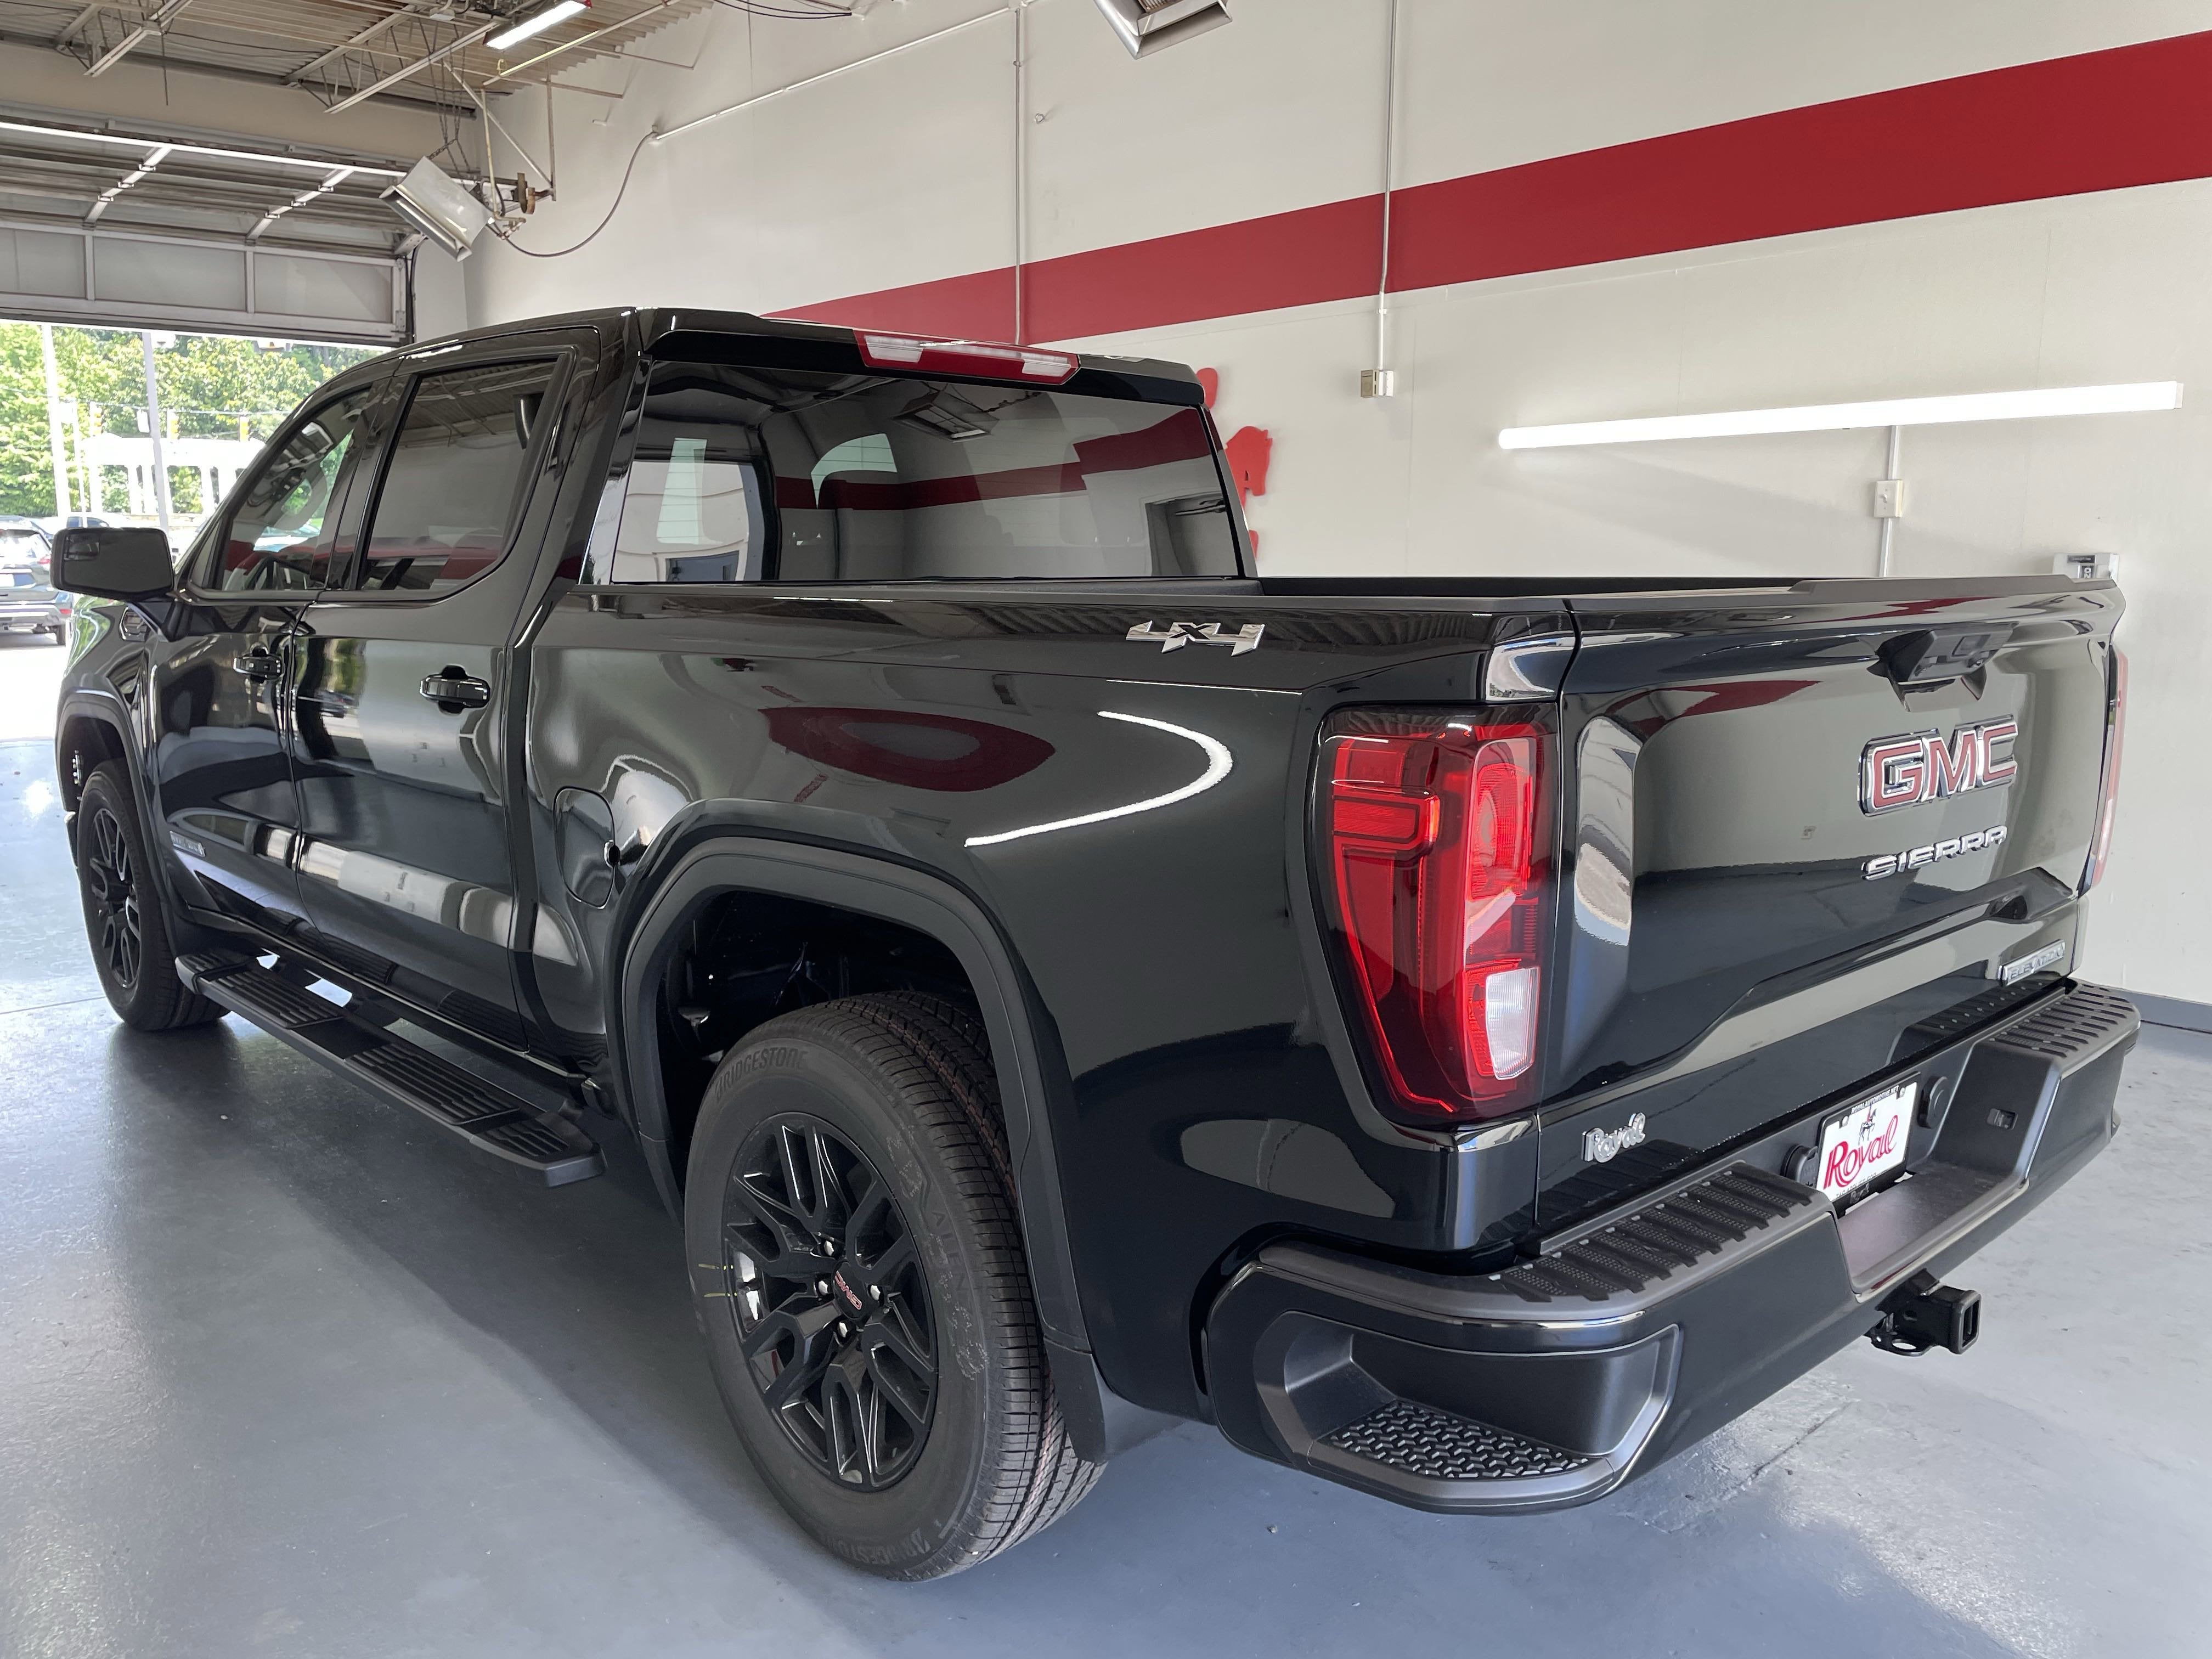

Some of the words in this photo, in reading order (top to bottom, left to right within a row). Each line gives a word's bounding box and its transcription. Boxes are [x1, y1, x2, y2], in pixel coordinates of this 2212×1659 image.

[1859, 715, 2018, 816] GMC
[1862, 825, 2007, 881] SIERRA
[1581, 1112, 1645, 1163] Royal
[1823, 1114, 1898, 1190] Royal
[834, 1270, 862, 1310] GMC
